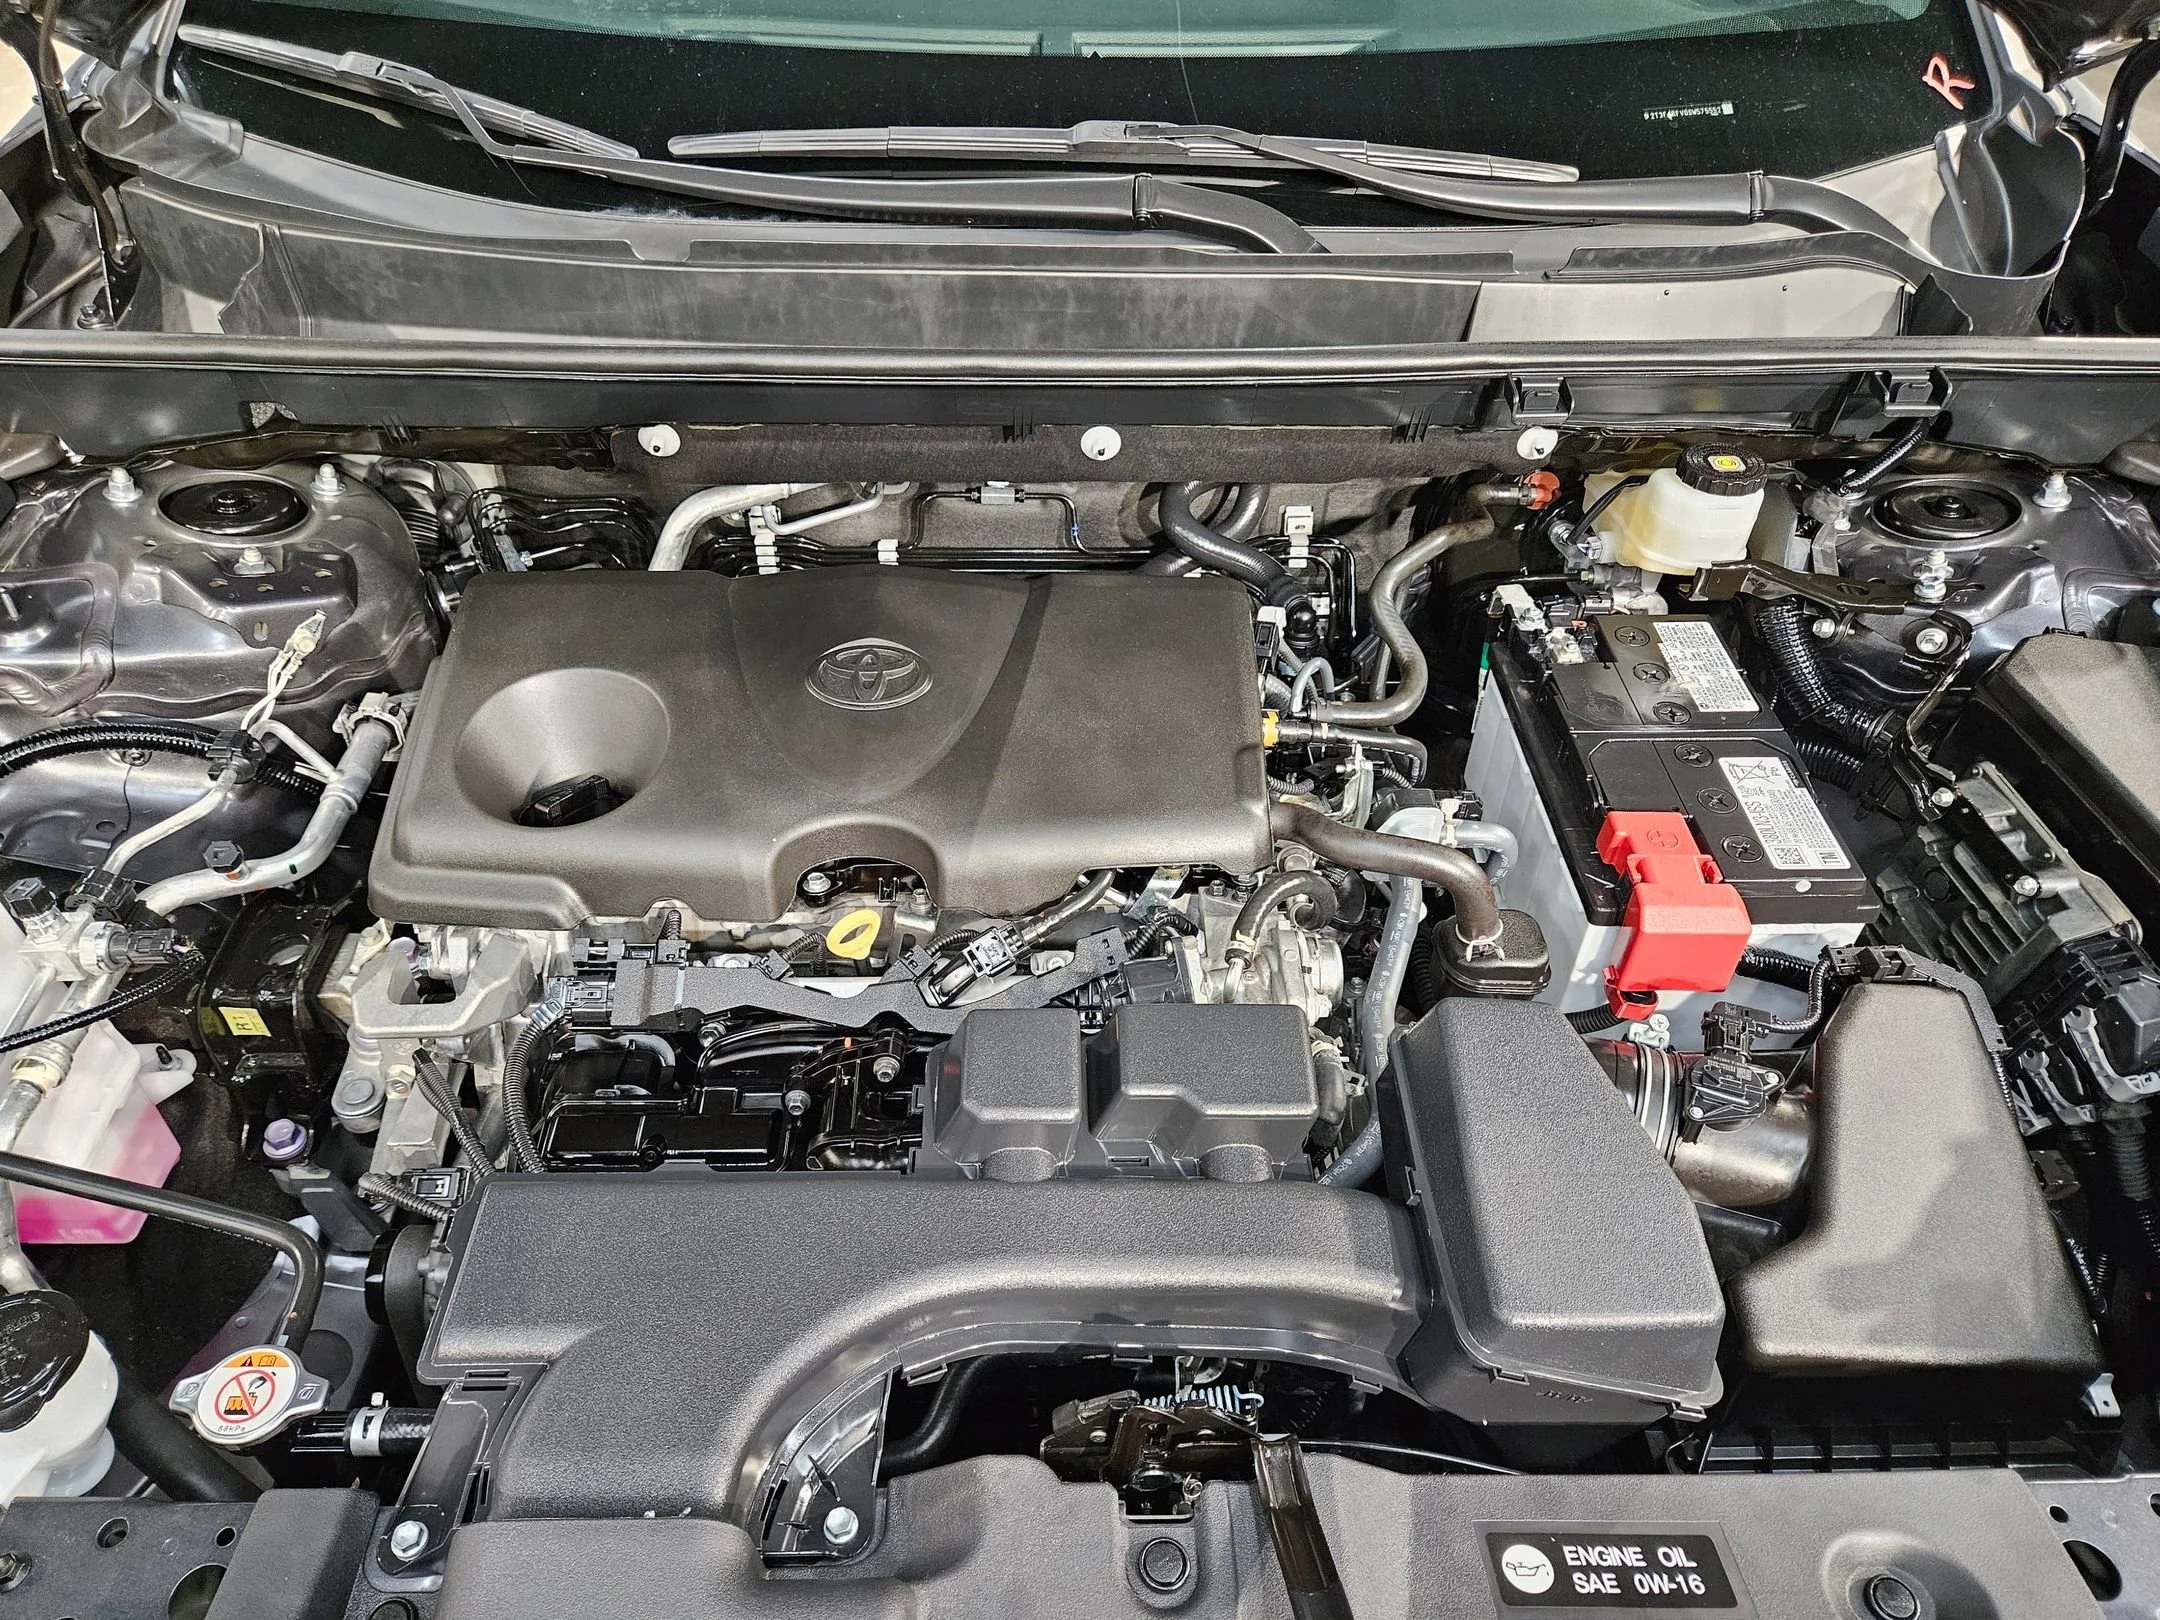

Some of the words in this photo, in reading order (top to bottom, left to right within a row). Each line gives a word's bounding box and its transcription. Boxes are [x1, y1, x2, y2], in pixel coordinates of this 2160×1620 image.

[1922, 53, 1975, 110] R
[1769, 766, 1782, 777] Pb
[1562, 1544, 1647, 1567] ENGINE
[1656, 1545, 1698, 1568] OIL
[1572, 1572, 1622, 1595] SAE
[1633, 1572, 1706, 1596] 0W-16
